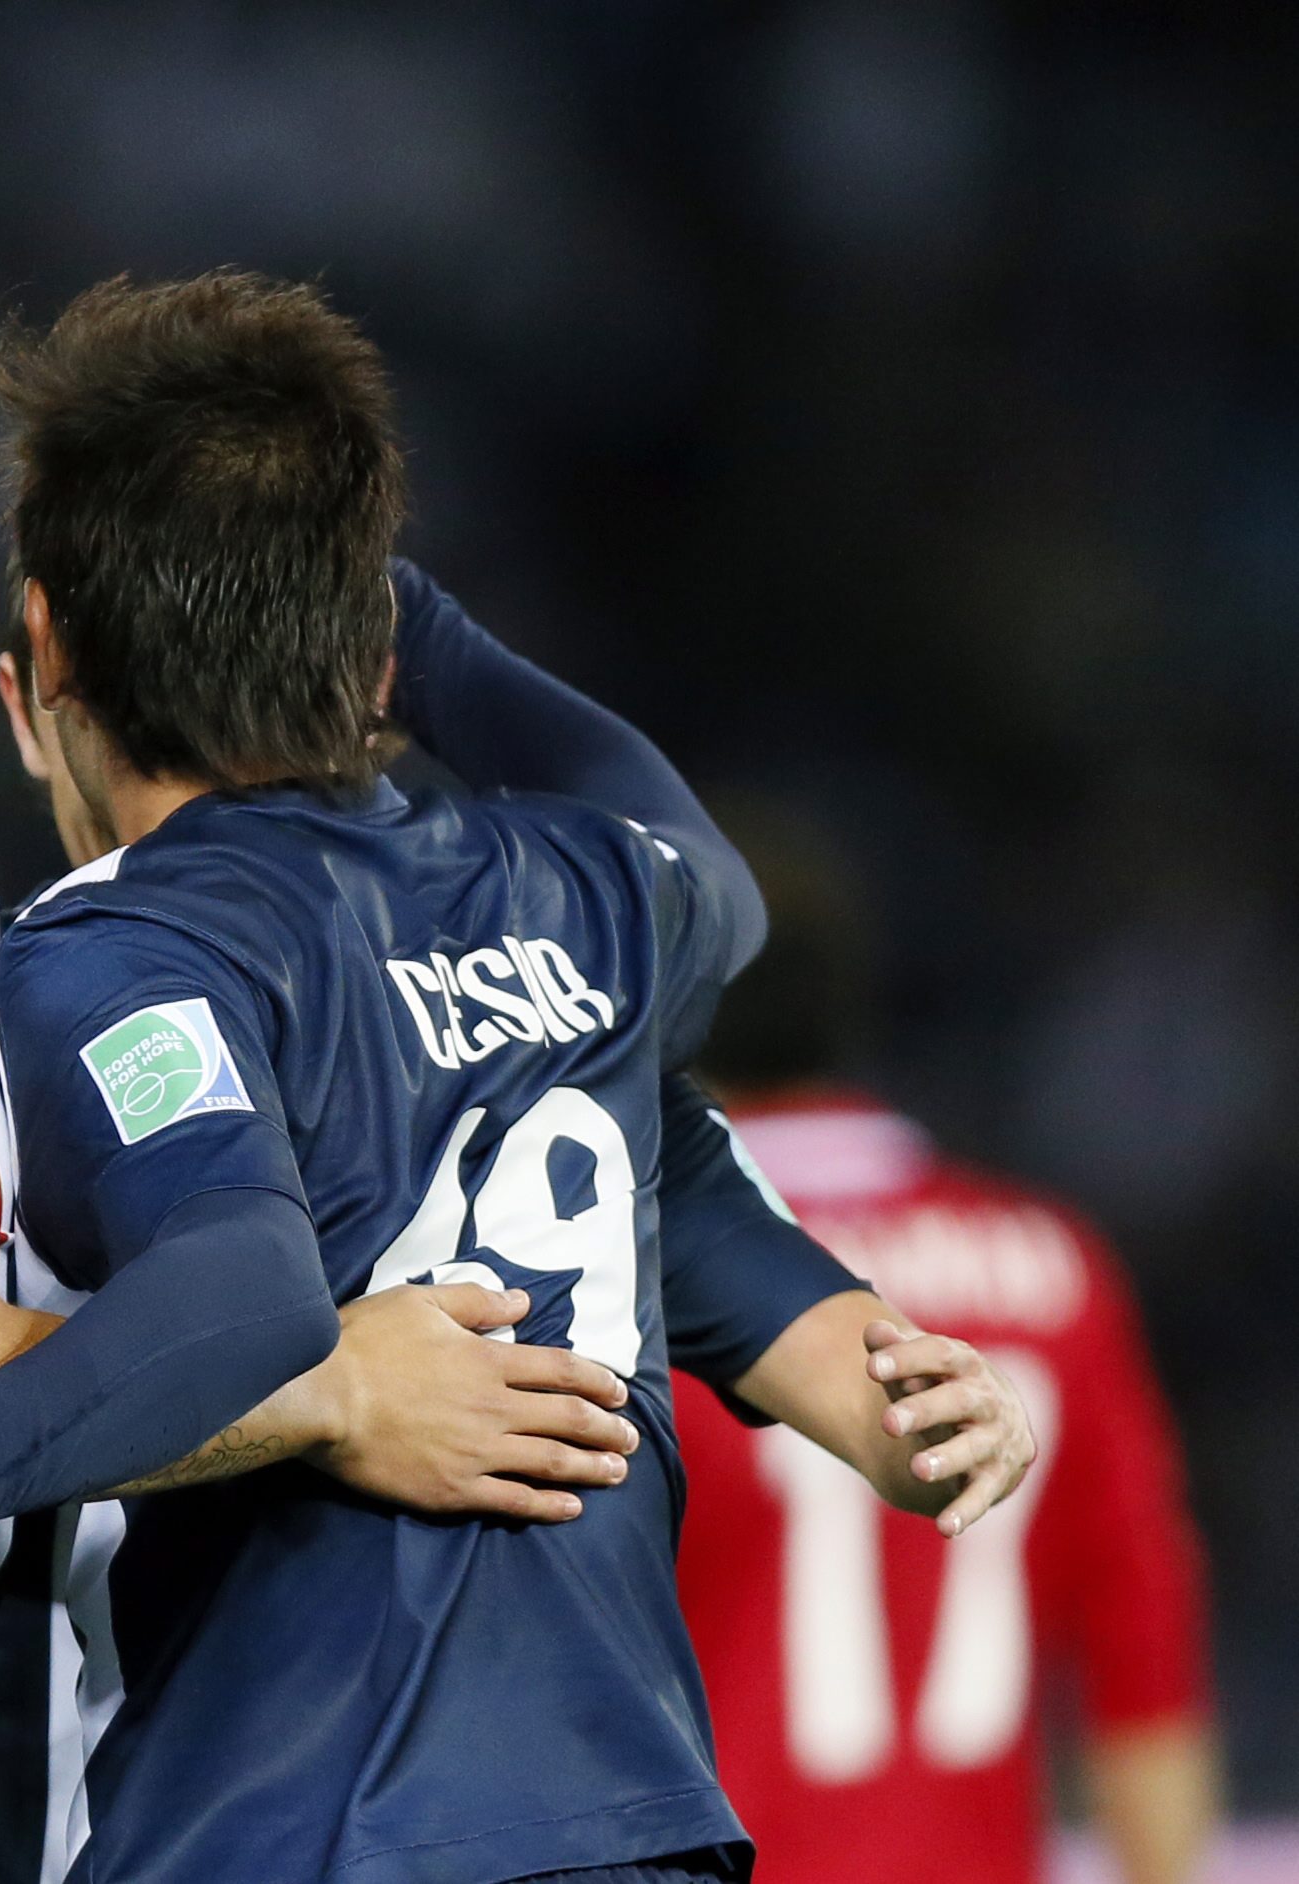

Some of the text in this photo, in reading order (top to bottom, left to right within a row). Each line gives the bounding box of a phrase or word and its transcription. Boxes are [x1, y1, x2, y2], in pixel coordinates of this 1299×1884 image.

[102, 1030, 184, 1081] FOOTBALL
[109, 1041, 185, 1091] FOR HOPE
[203, 1096, 243, 1107] FIFA
